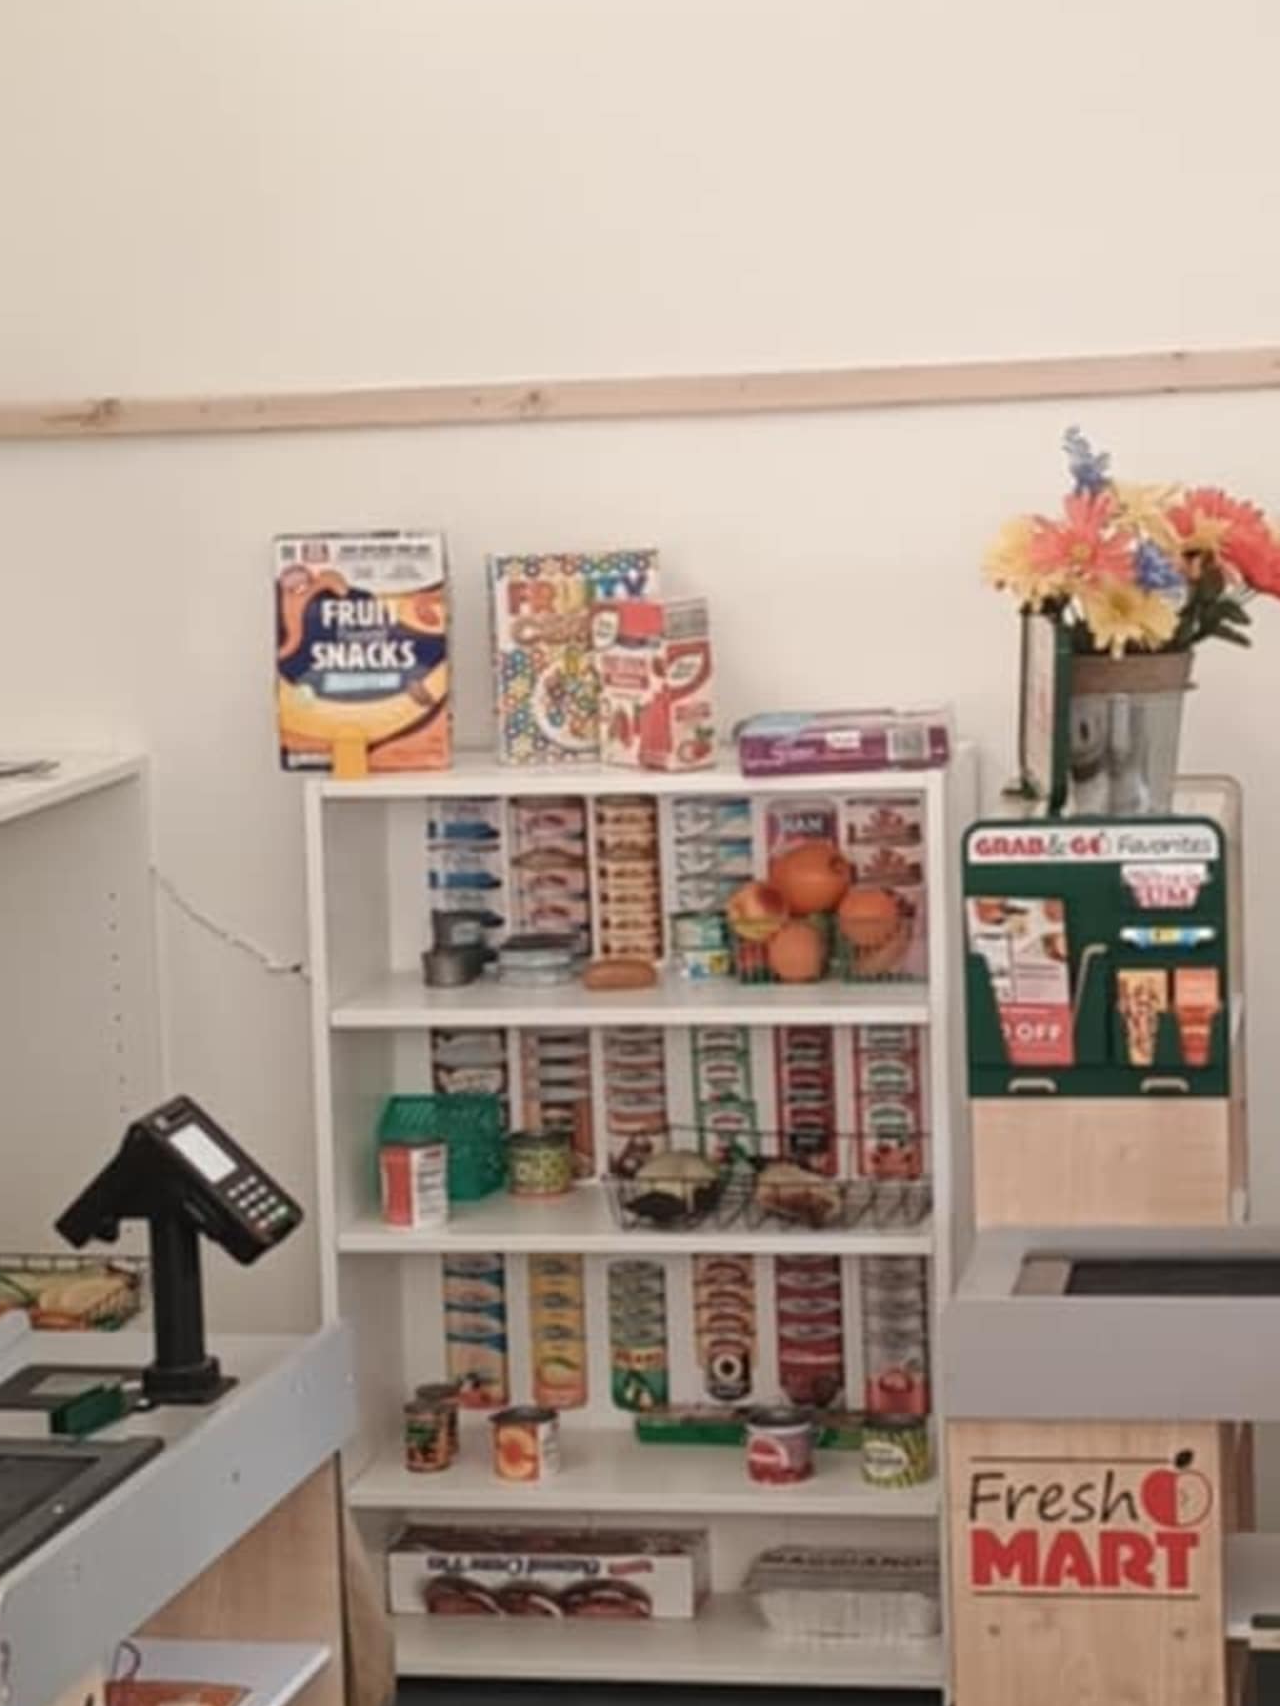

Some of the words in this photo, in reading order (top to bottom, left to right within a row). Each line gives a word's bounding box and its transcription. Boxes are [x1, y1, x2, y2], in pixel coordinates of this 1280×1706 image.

[320, 599, 399, 629] FRUIT
[311, 640, 416, 671] SNACKS
[973, 836, 1045, 857] GRAB
[1017, 1021, 1061, 1041] OFF
[969, 1469, 1139, 1524] Fresh
[970, 1528, 1200, 1590] MART
